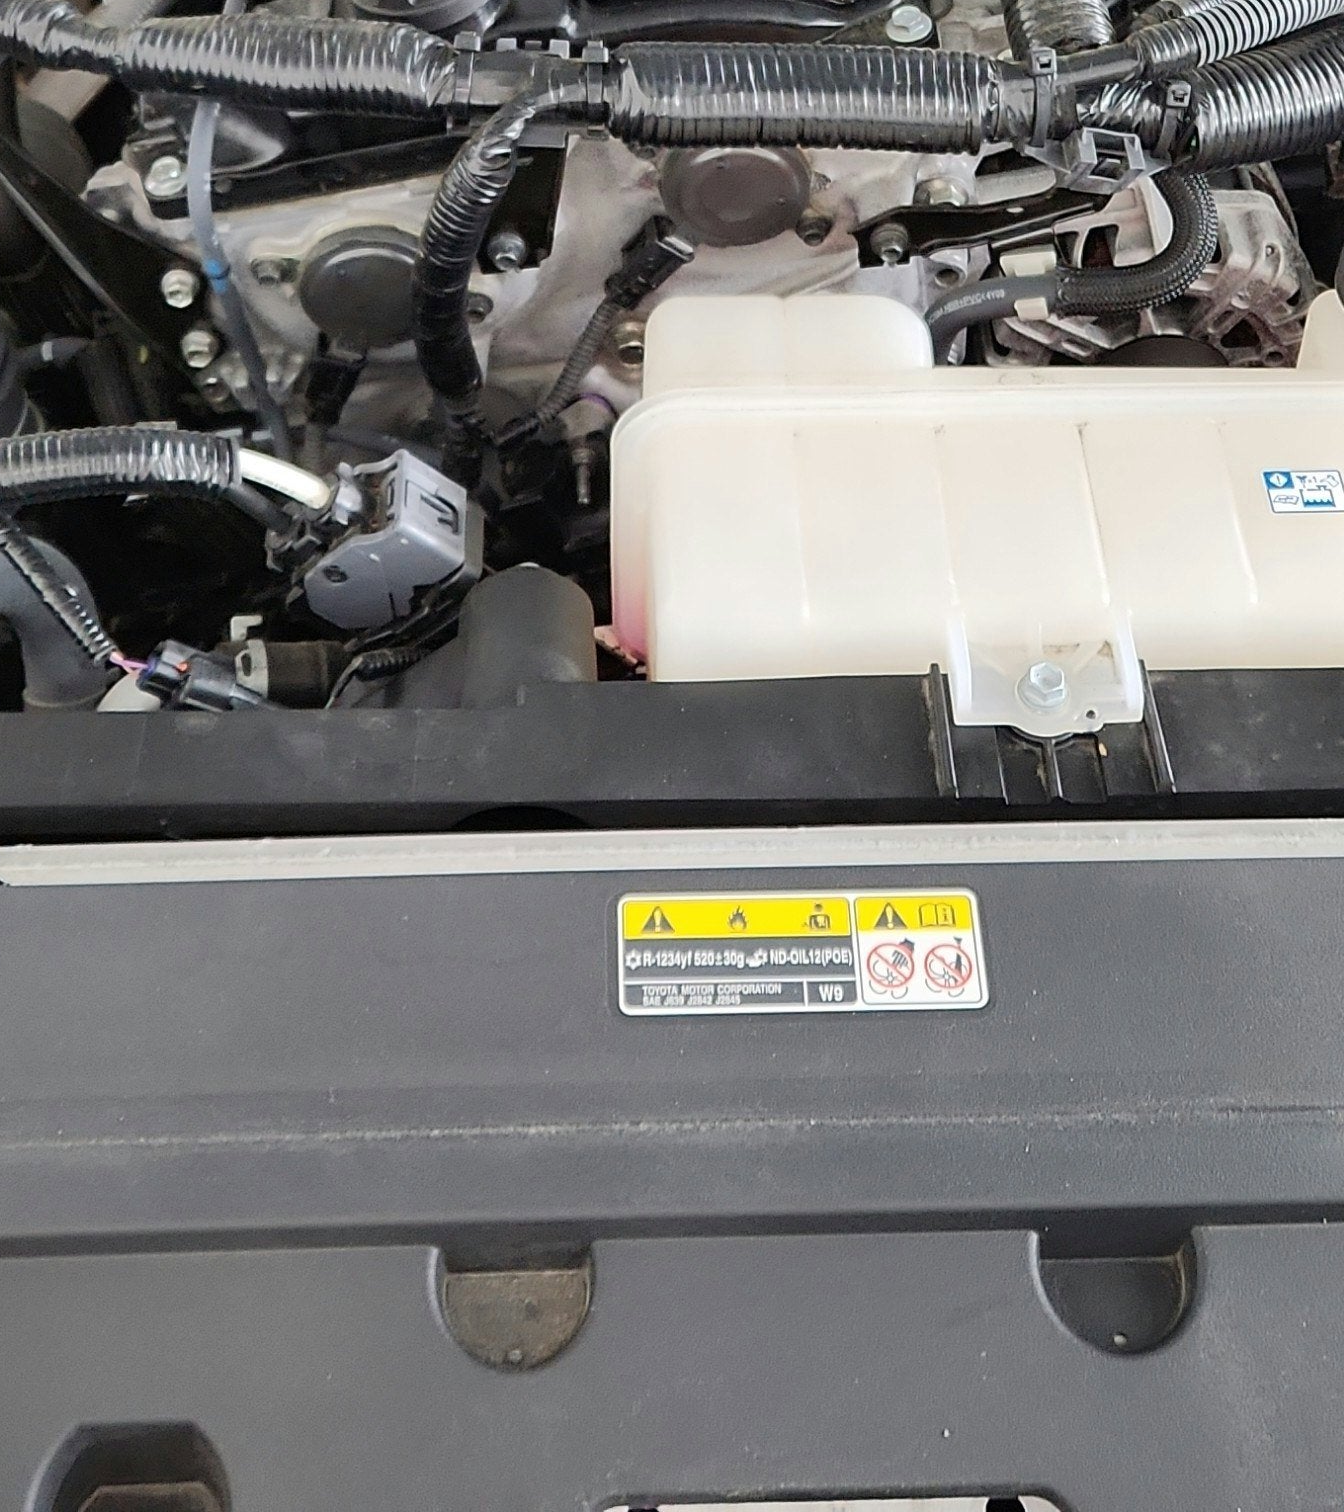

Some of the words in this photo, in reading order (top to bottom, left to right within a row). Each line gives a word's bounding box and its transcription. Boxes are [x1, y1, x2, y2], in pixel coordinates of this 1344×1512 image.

[642, 948, 692, 971] R-1234yf
[693, 948, 746, 970] 520±30g
[769, 947, 854, 969] ND-OIL12(POE)
[641, 985, 678, 997] TOYOTA
[680, 984, 715, 996] MOTOR
[716, 982, 782, 996] CORPORATION
[818, 985, 845, 1003] W9
[642, 996, 662, 1007] SAE
